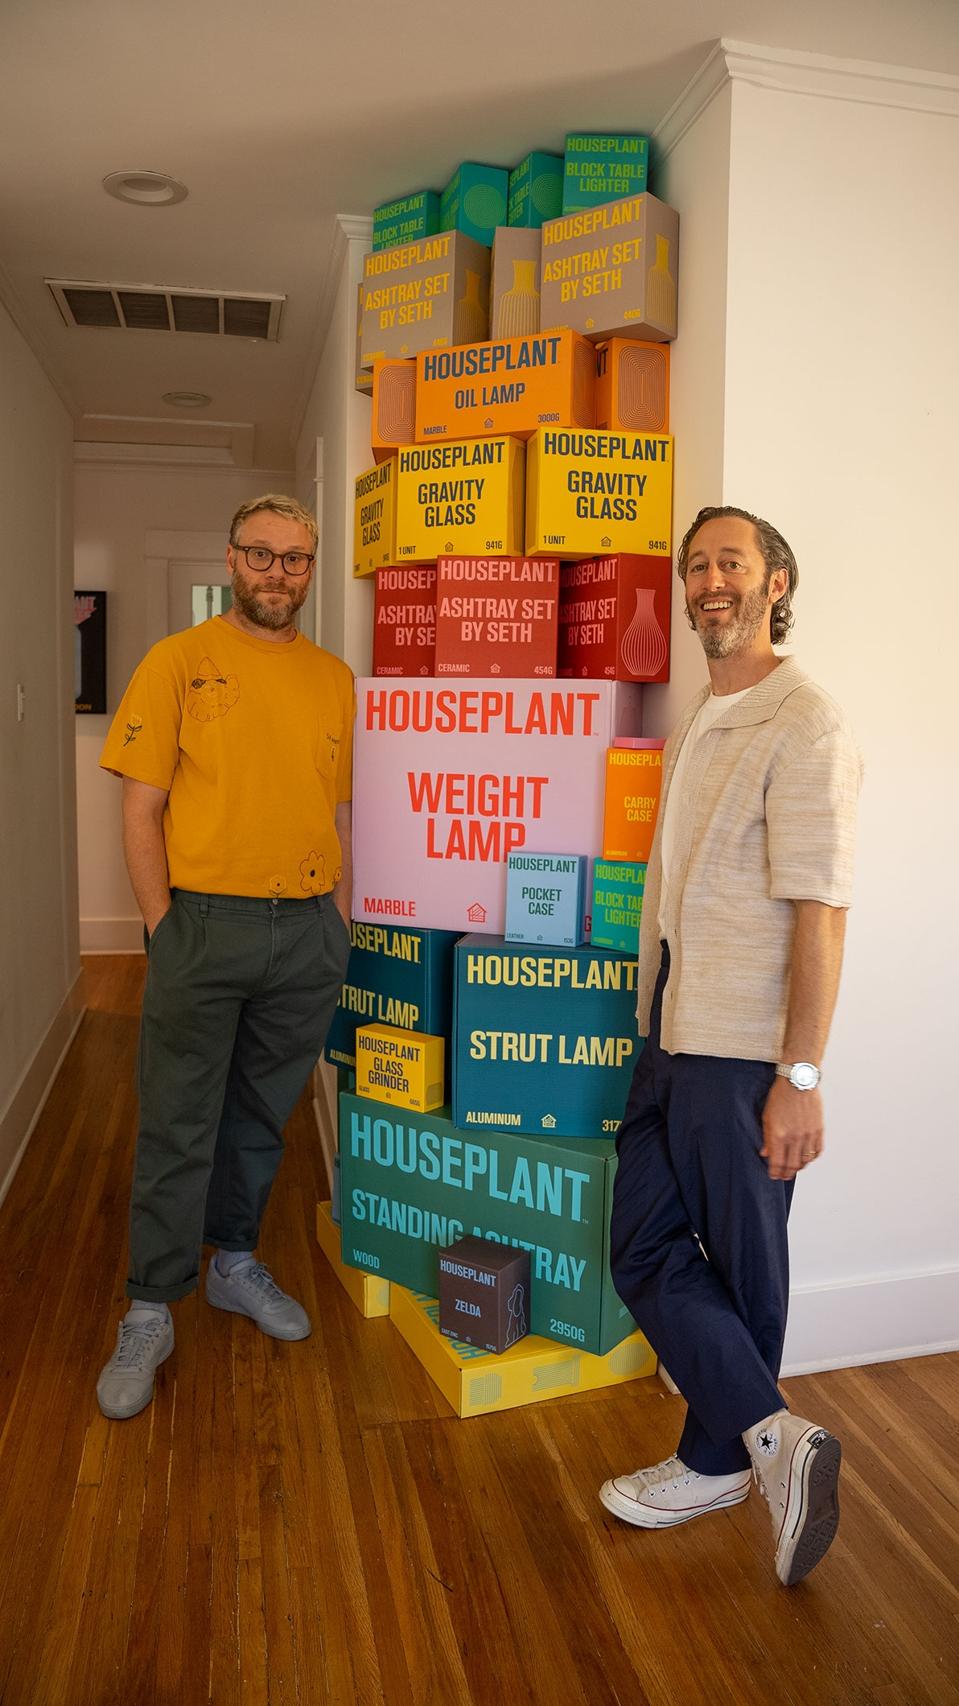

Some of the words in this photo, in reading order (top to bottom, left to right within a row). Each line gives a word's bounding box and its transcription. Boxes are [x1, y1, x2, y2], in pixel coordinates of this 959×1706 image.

[567, 138, 647, 153] HOUSEPLANT
[566, 161, 605, 176] BLOCK
[608, 163, 645, 178] TABLE
[580, 178, 629, 192] LIGHTER
[374, 195, 425, 221] HOUSEPLANT
[373, 226, 397, 245] BLOCK
[400, 217, 424, 234] TABLE
[544, 199, 643, 246] HOUSEPLANT
[366, 237, 450, 277] HOUSEPLANT
[543, 246, 609, 283] ASHTRAY
[612, 238, 642, 265] SET
[365, 280, 422, 311] ASHTRAY
[424, 273, 450, 297] SET
[561, 279, 579, 303] BY
[582, 268, 622, 298] SETH
[380, 308, 396, 330] BY
[399, 300, 433, 324] SETH
[424, 337, 561, 381] HOUSEPLANT
[455, 387, 478, 409] OIL
[482, 382, 525, 406] LAMP
[424, 425, 447, 435] MARBLE
[400, 442, 505, 472] HOUSEPLANT
[544, 432, 669, 462] HOUSEPLANT
[355, 463, 391, 499] HOUSEPLANT
[418, 479, 485, 505] GRAVITY
[568, 470, 647, 496] GRAVITY
[361, 498, 384, 526] GRAVITY
[425, 503, 476, 528] GLASS
[576, 496, 637, 521] GLASS
[362, 522, 380, 546] GLASS
[486, 541, 502, 550] 941G
[548, 536, 565, 544] UNIT
[649, 541, 667, 550] 941G
[403, 546, 416, 555] UNIT
[440, 560, 555, 582] HOUSEPLANT
[439, 597, 518, 619] ASHTRAY
[522, 600, 555, 620] SET
[598, 598, 616, 620] SET
[395, 628, 413, 646] BY
[461, 621, 483, 641] BY
[487, 622, 532, 643] SETH
[568, 626, 579, 645] BY
[580, 624, 604, 645] SETH
[377, 666, 403, 675] CERAMIC
[438, 664, 470, 673] CERAMIC
[534, 666, 552, 675] 454G
[366, 690, 600, 736] HOUSEPLANT
[407, 772, 548, 819] WEIGHT
[624, 796, 656, 809] CARRY
[627, 809, 652, 822] CASE
[427, 818, 526, 863] LAMP
[509, 857, 576, 873] HOUSEPLANT
[522, 887, 562, 902] POCKET
[595, 891, 624, 907] BLOCK
[364, 897, 416, 917] MARBLE
[529, 902, 554, 916] CASE
[467, 955, 639, 991] HOUSEPLANT
[337, 984, 375, 1017] TRUT
[378, 995, 419, 1029] LAMP
[358, 1035, 420, 1062] HOUSEPLANT
[470, 1030, 552, 1063] STRUT
[558, 1035, 633, 1067] LAMP
[374, 1057, 403, 1077] GLASS
[368, 1070, 409, 1093] GRINDER
[466, 1112, 521, 1126] ALUMINUM
[351, 1112, 590, 1223] HOUSEPLANT
[353, 1249, 380, 1270] WOOD
[440, 1259, 496, 1287] HOUSEPLANT
[455, 1299, 481, 1318] ZELDA
[550, 1319, 585, 1343] 2950G
